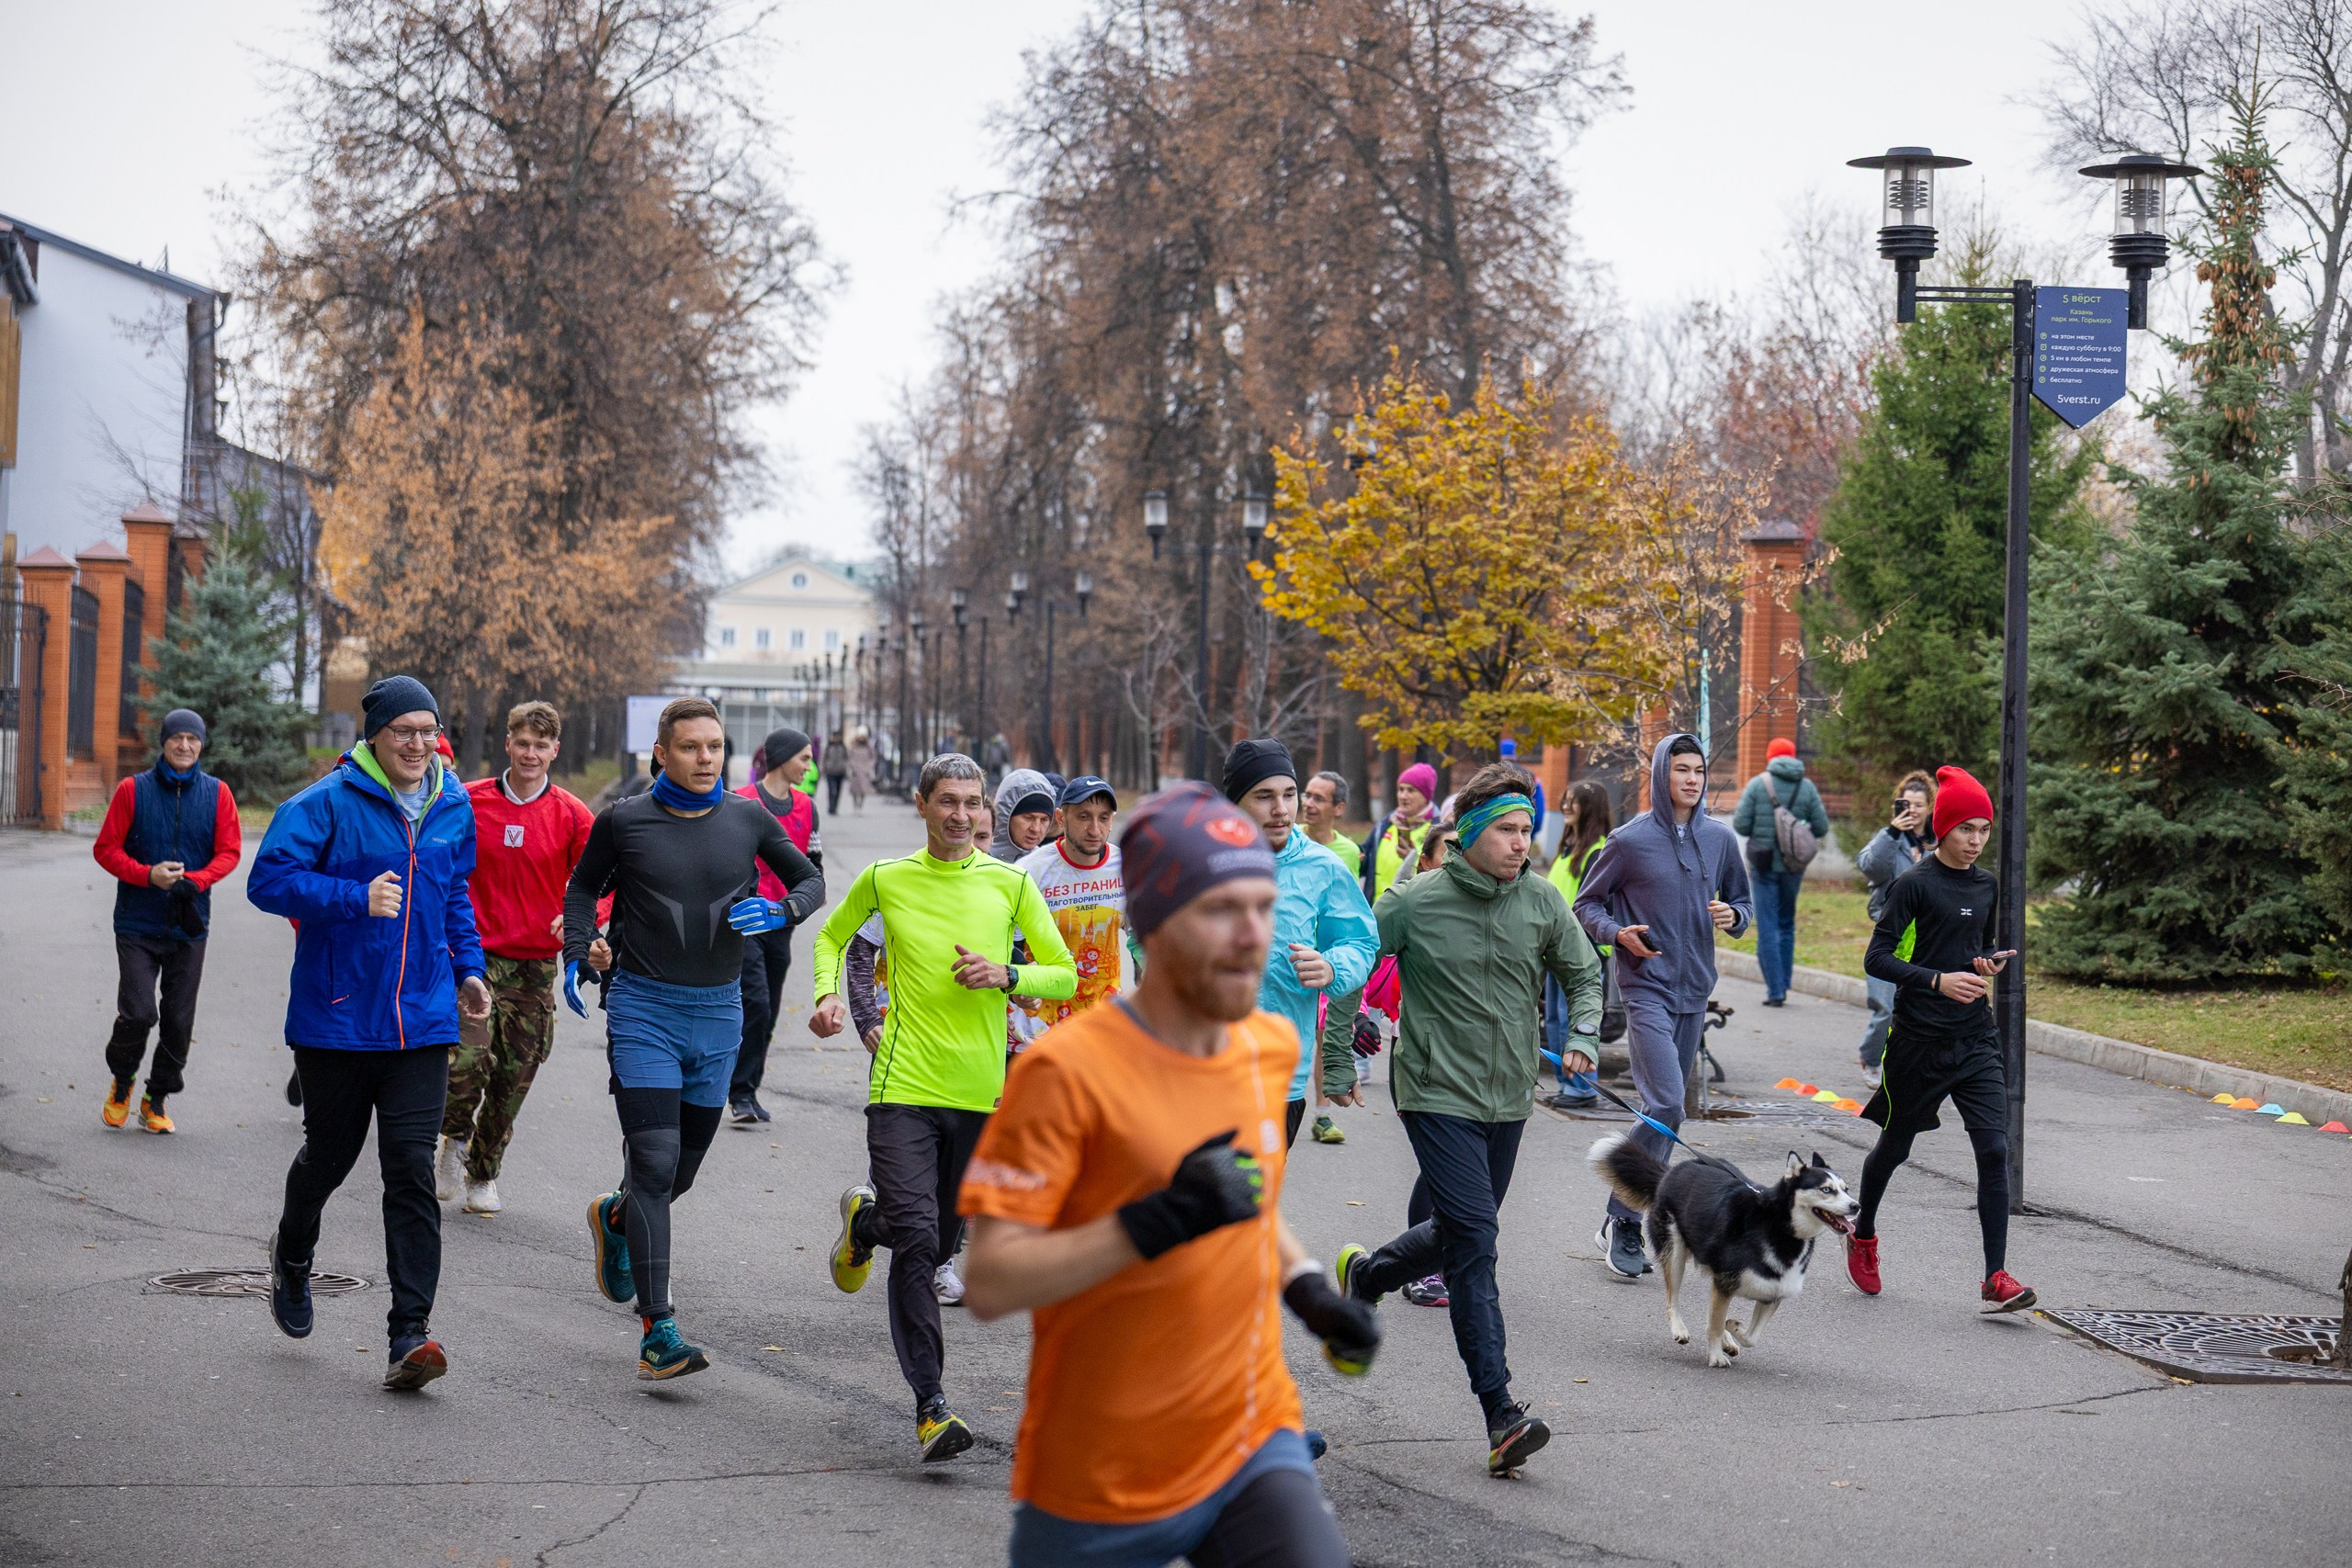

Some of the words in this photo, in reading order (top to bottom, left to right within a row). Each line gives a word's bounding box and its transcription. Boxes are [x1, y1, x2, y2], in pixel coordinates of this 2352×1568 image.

[2062, 294, 2069, 303] 5
[2071, 293, 2102, 304] вёрст
[2081, 316, 2112, 324] Горького
[2076, 344, 2102, 353] субботу
[2057, 394, 2101, 405] 5verst.ru
[1044, 885, 1069, 898] БЕЗ
[1075, 903, 1100, 912] ЗАБЕГ
